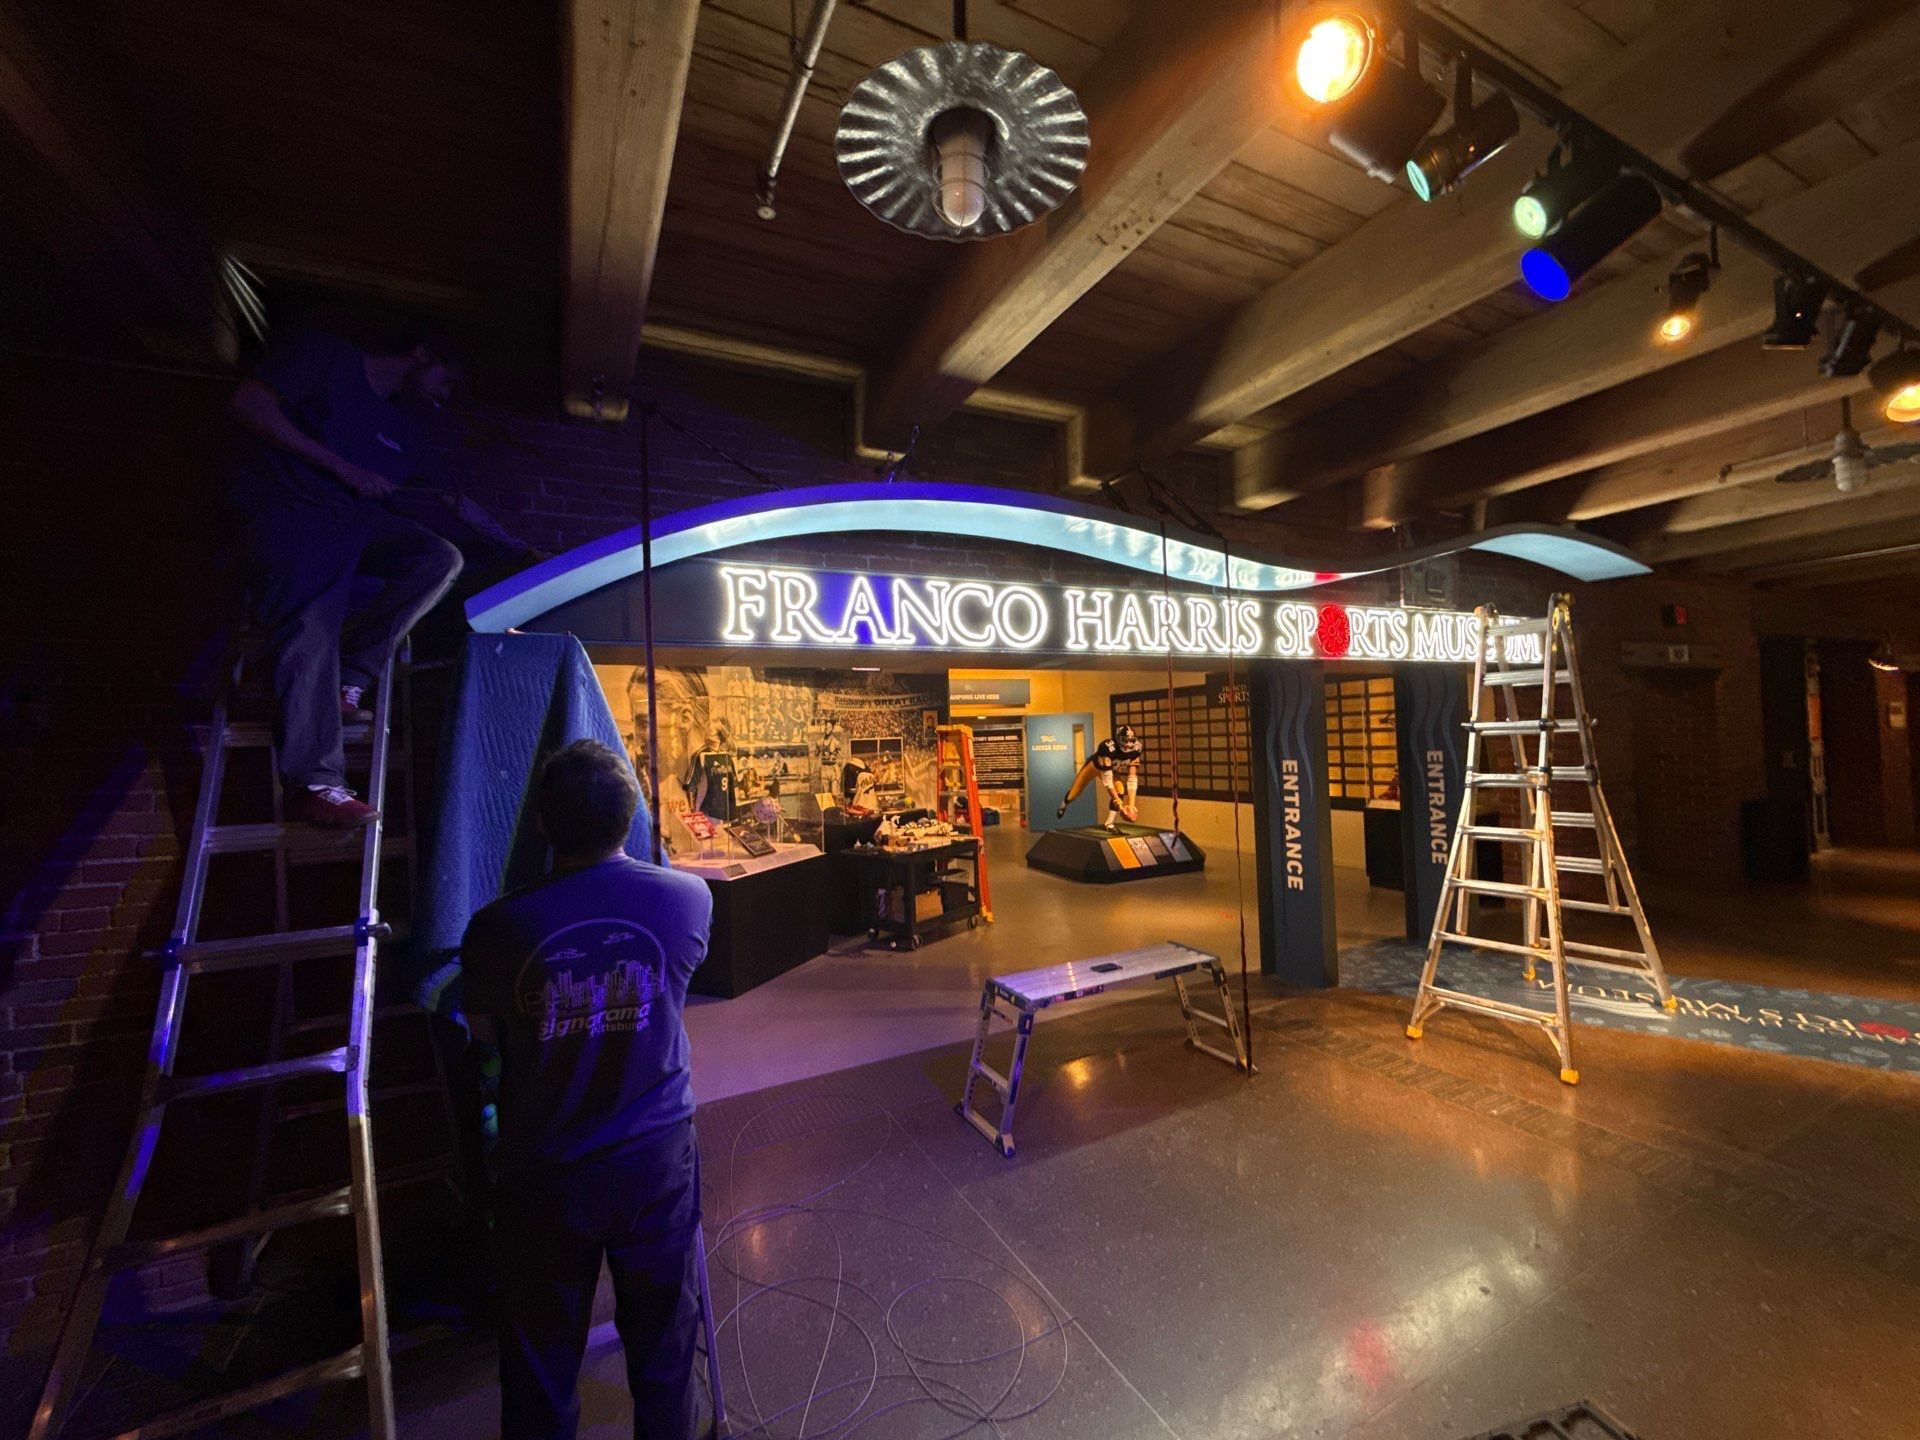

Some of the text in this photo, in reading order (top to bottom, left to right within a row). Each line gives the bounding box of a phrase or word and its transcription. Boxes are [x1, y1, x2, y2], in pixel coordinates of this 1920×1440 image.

[720, 567, 1048, 648] FRANCO
[1063, 589, 1265, 655] HARRIS
[1273, 602, 1409, 660] SPORTS
[1282, 758, 1305, 892] ENTRANCE
[1427, 750, 1449, 866] ENTRANCE
